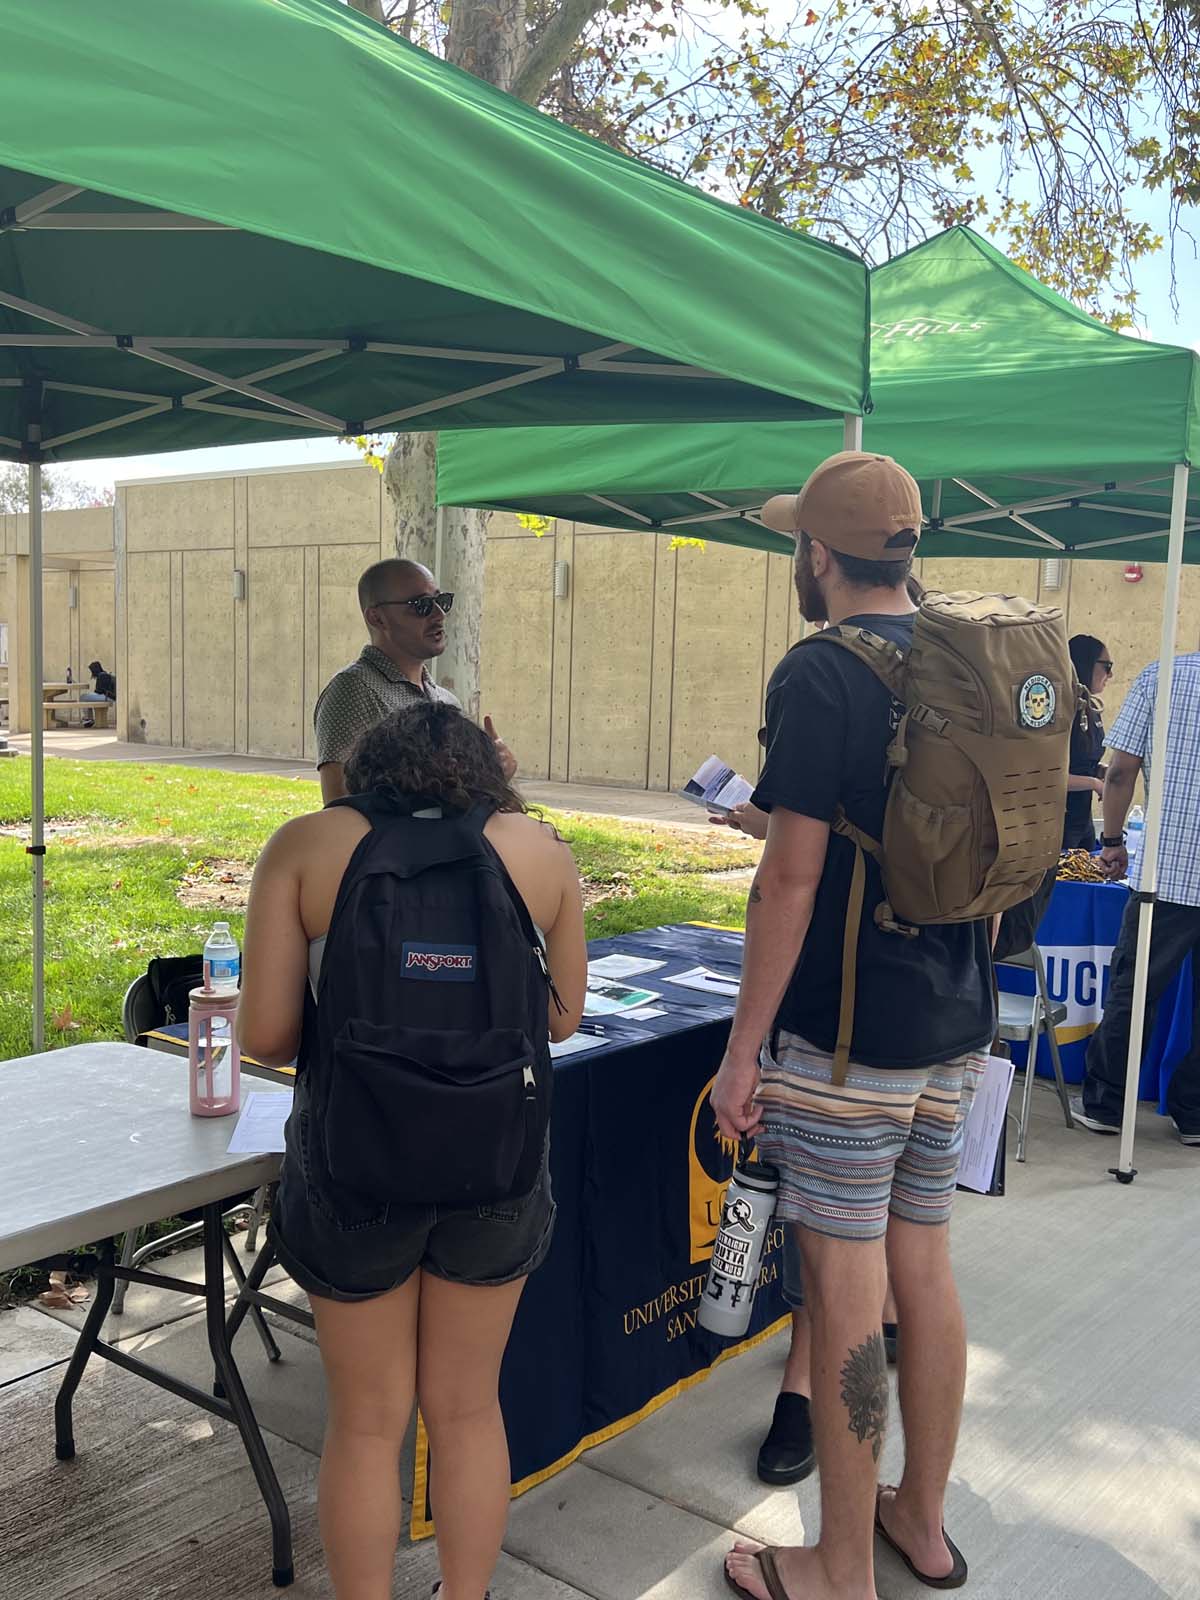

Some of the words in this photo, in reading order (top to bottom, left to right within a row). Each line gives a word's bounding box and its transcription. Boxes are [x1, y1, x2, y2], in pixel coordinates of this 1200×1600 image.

[405, 951, 472, 971] JANSPORT
[623, 1273, 708, 1335] UNIVERSIT
[666, 1308, 701, 1342] SAN
